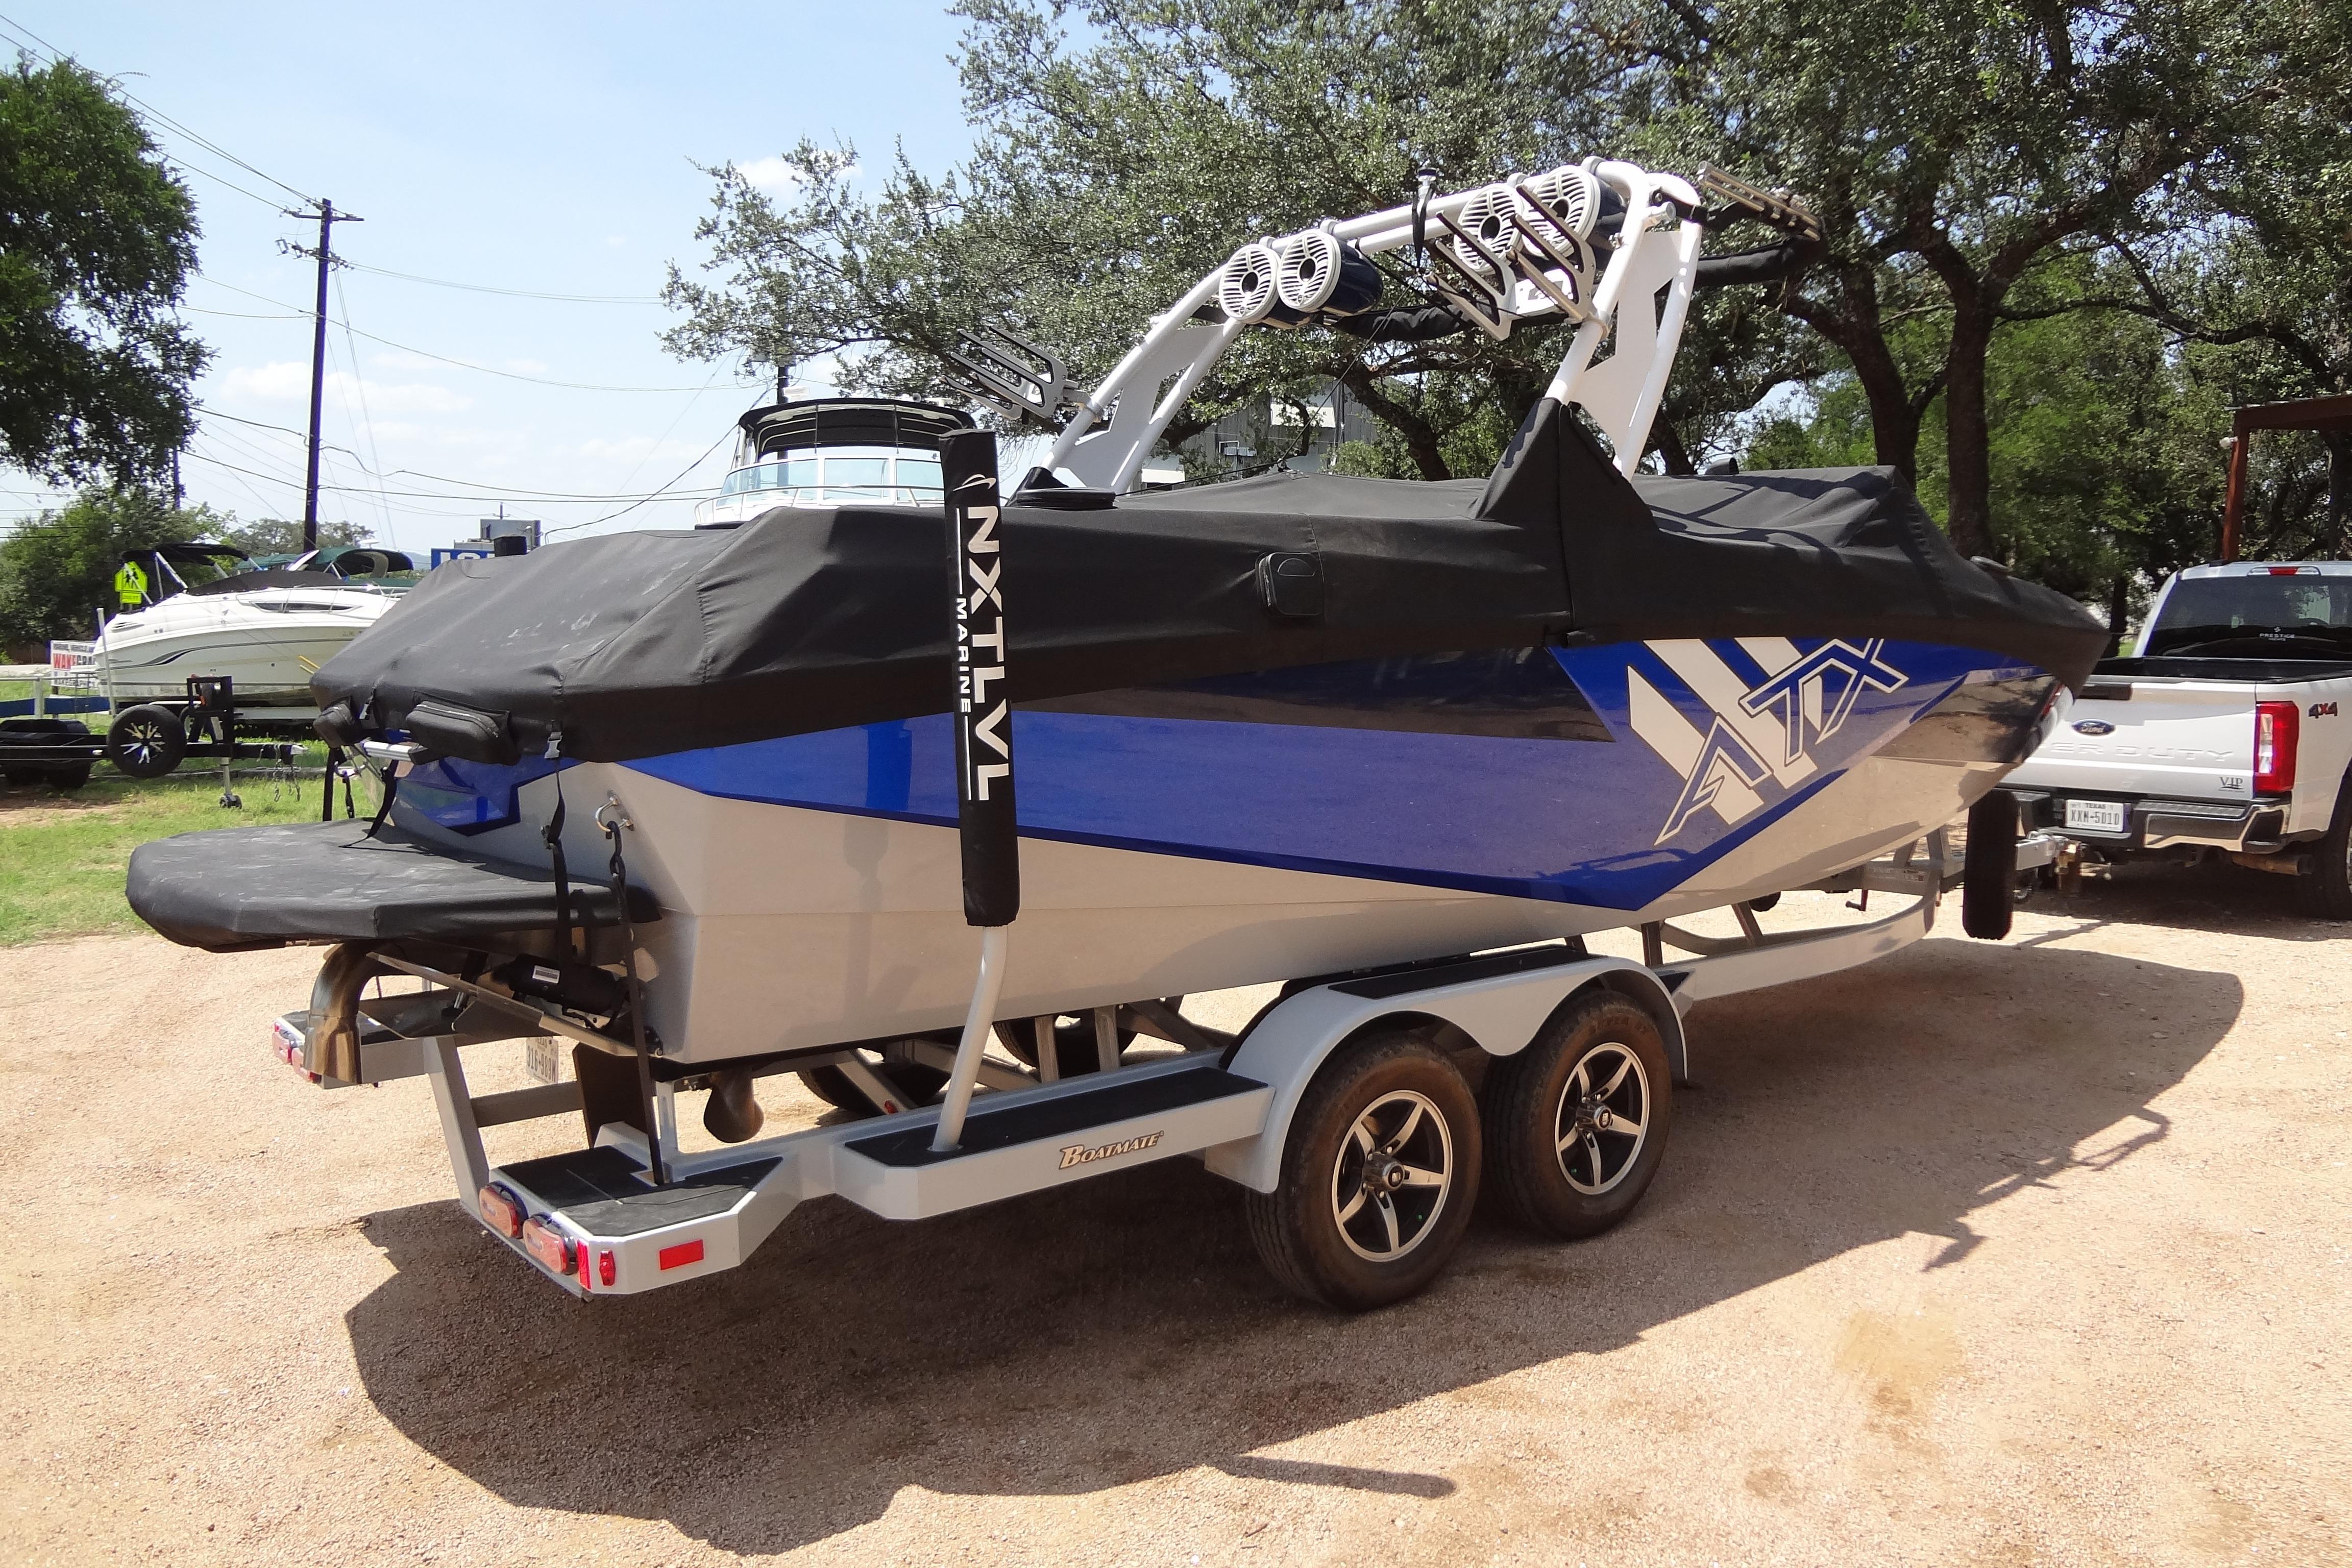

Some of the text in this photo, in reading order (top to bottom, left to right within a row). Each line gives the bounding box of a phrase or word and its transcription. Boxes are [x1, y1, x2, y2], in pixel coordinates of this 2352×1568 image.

[956, 597, 971, 714] MARINE
[968, 506, 1010, 801] NXTLVL
[2115, 745, 2234, 762] DUTY
[2219, 776, 2243, 787] VIP
